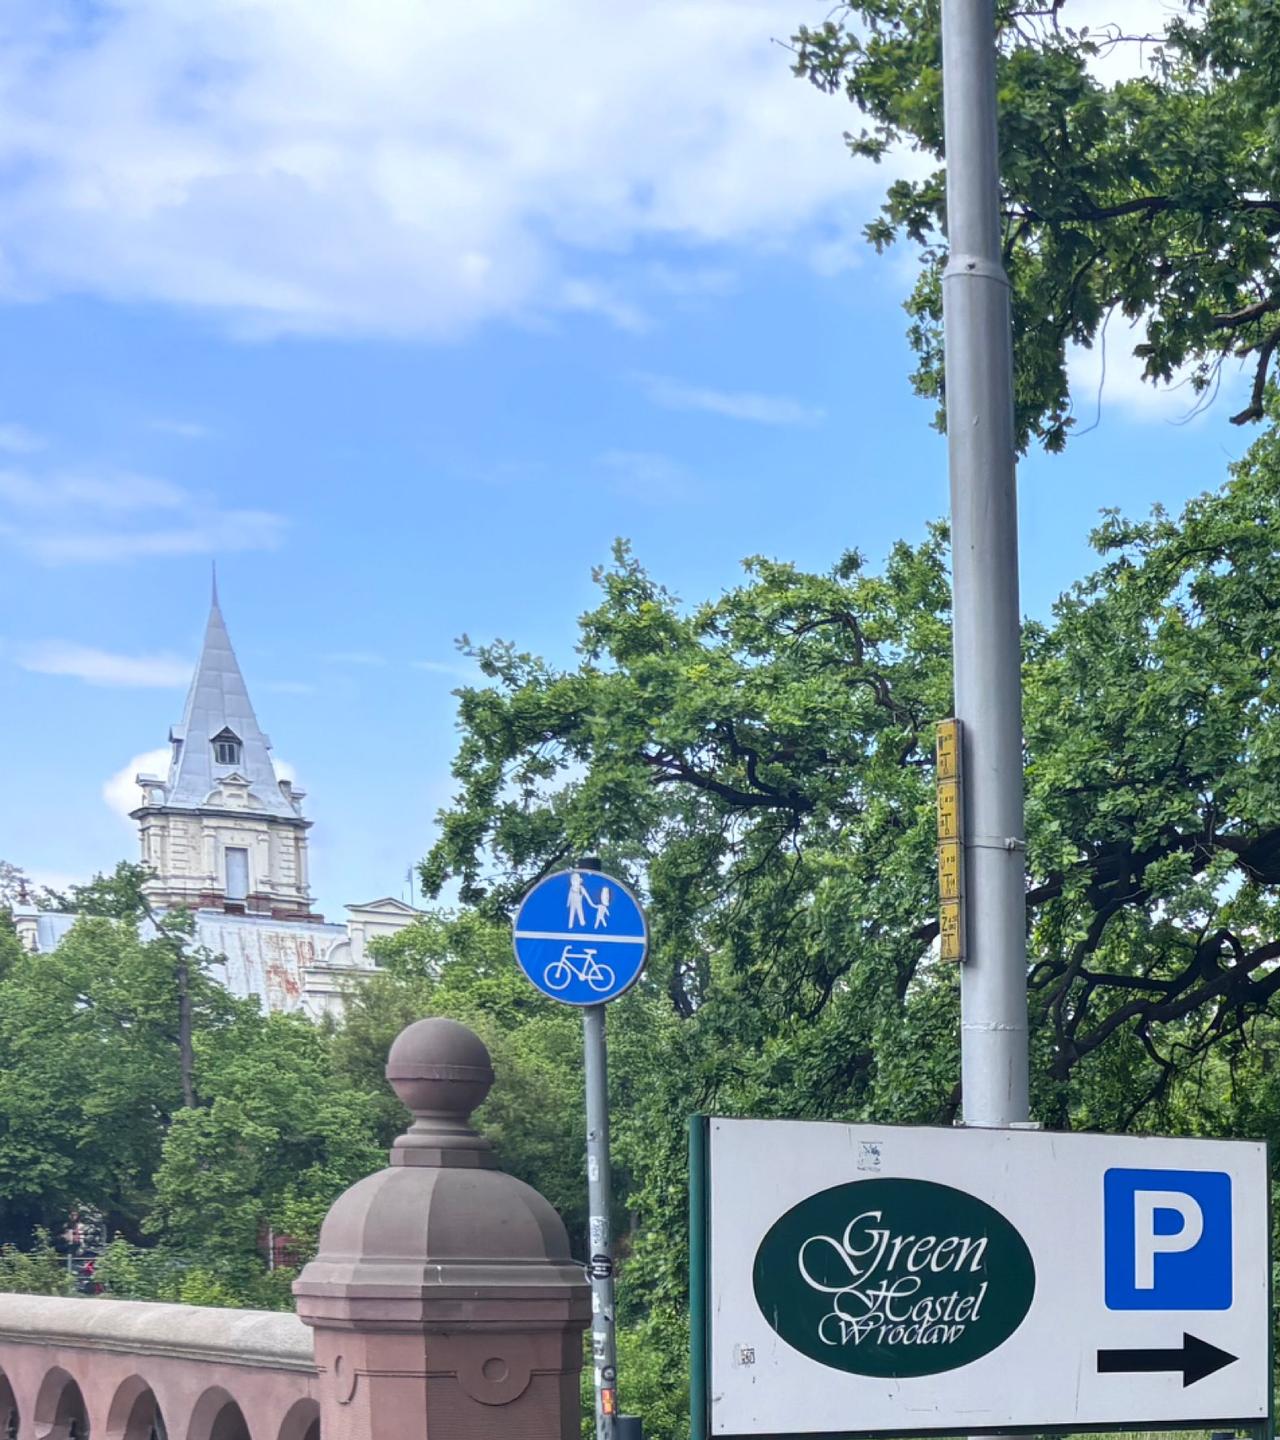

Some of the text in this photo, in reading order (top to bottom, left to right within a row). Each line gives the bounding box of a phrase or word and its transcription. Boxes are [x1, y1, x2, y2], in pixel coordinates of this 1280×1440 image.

[798, 1211, 988, 1293] Green
[1134, 1190, 1204, 1290] P
[834, 1276, 988, 1322] Hostel
